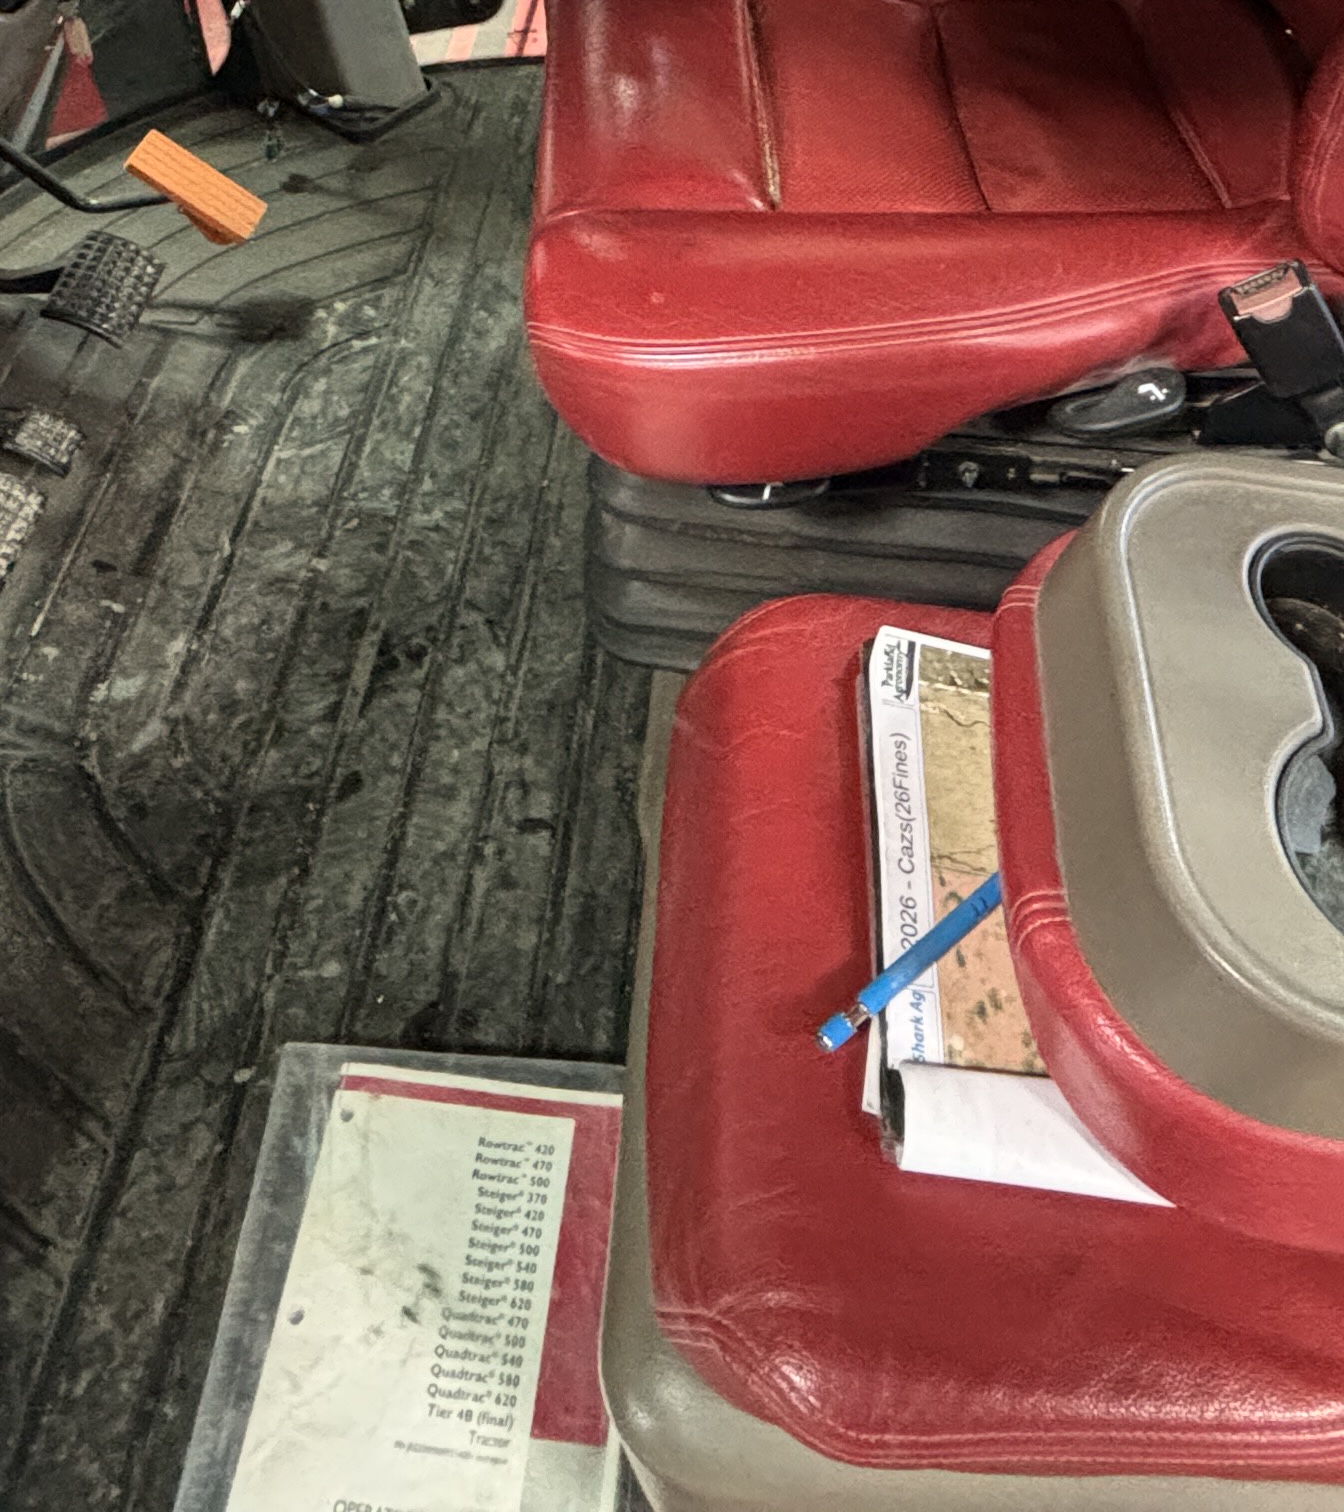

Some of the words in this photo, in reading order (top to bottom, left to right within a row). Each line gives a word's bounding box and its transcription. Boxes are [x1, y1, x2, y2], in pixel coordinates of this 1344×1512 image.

[889, 732, 916, 875] Cazs(26Fines)
[899, 895, 918, 951] 2026
[910, 990, 926, 1013] Ag
[532, 1160, 553, 1172] 470
[530, 1176, 550, 1188] 500
[522, 1226, 542, 1239] 470
[520, 1243, 540, 1256] 500
[516, 1261, 537, 1274] 540
[508, 1317, 529, 1330] 470
[494, 1393, 517, 1408] 620
[427, 1403, 453, 1419] Tier
[477, 1410, 514, 1432] (final)
